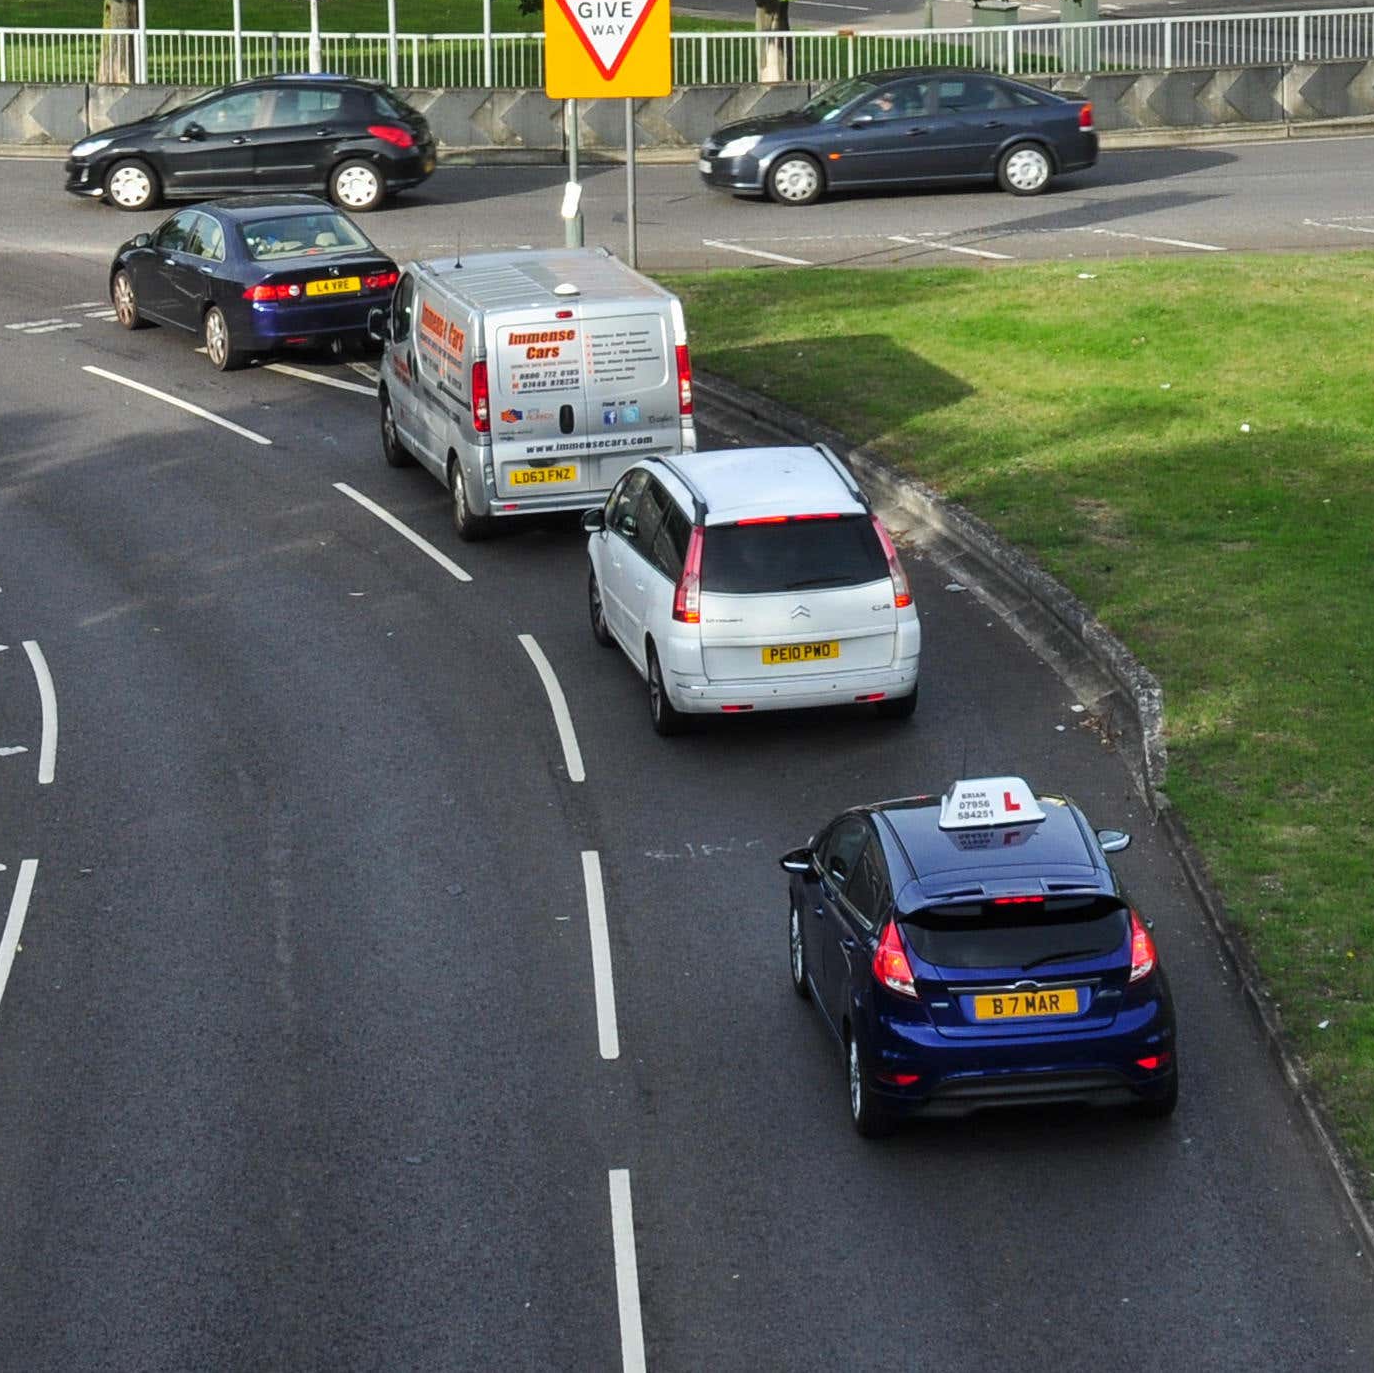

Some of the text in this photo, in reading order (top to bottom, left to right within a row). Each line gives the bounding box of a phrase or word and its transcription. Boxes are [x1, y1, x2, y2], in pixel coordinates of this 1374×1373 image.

[578, 1, 633, 19] GIVE
[591, 24, 624, 36] WAY
[508, 329, 576, 346] Immense
[526, 346, 560, 360] Cars
[526, 435, 653, 454] www.immensecars.com
[514, 468, 571, 484] LD63 FNZ
[1003, 791, 1021, 812] L
[992, 994, 1060, 1015] B 7 MAR
